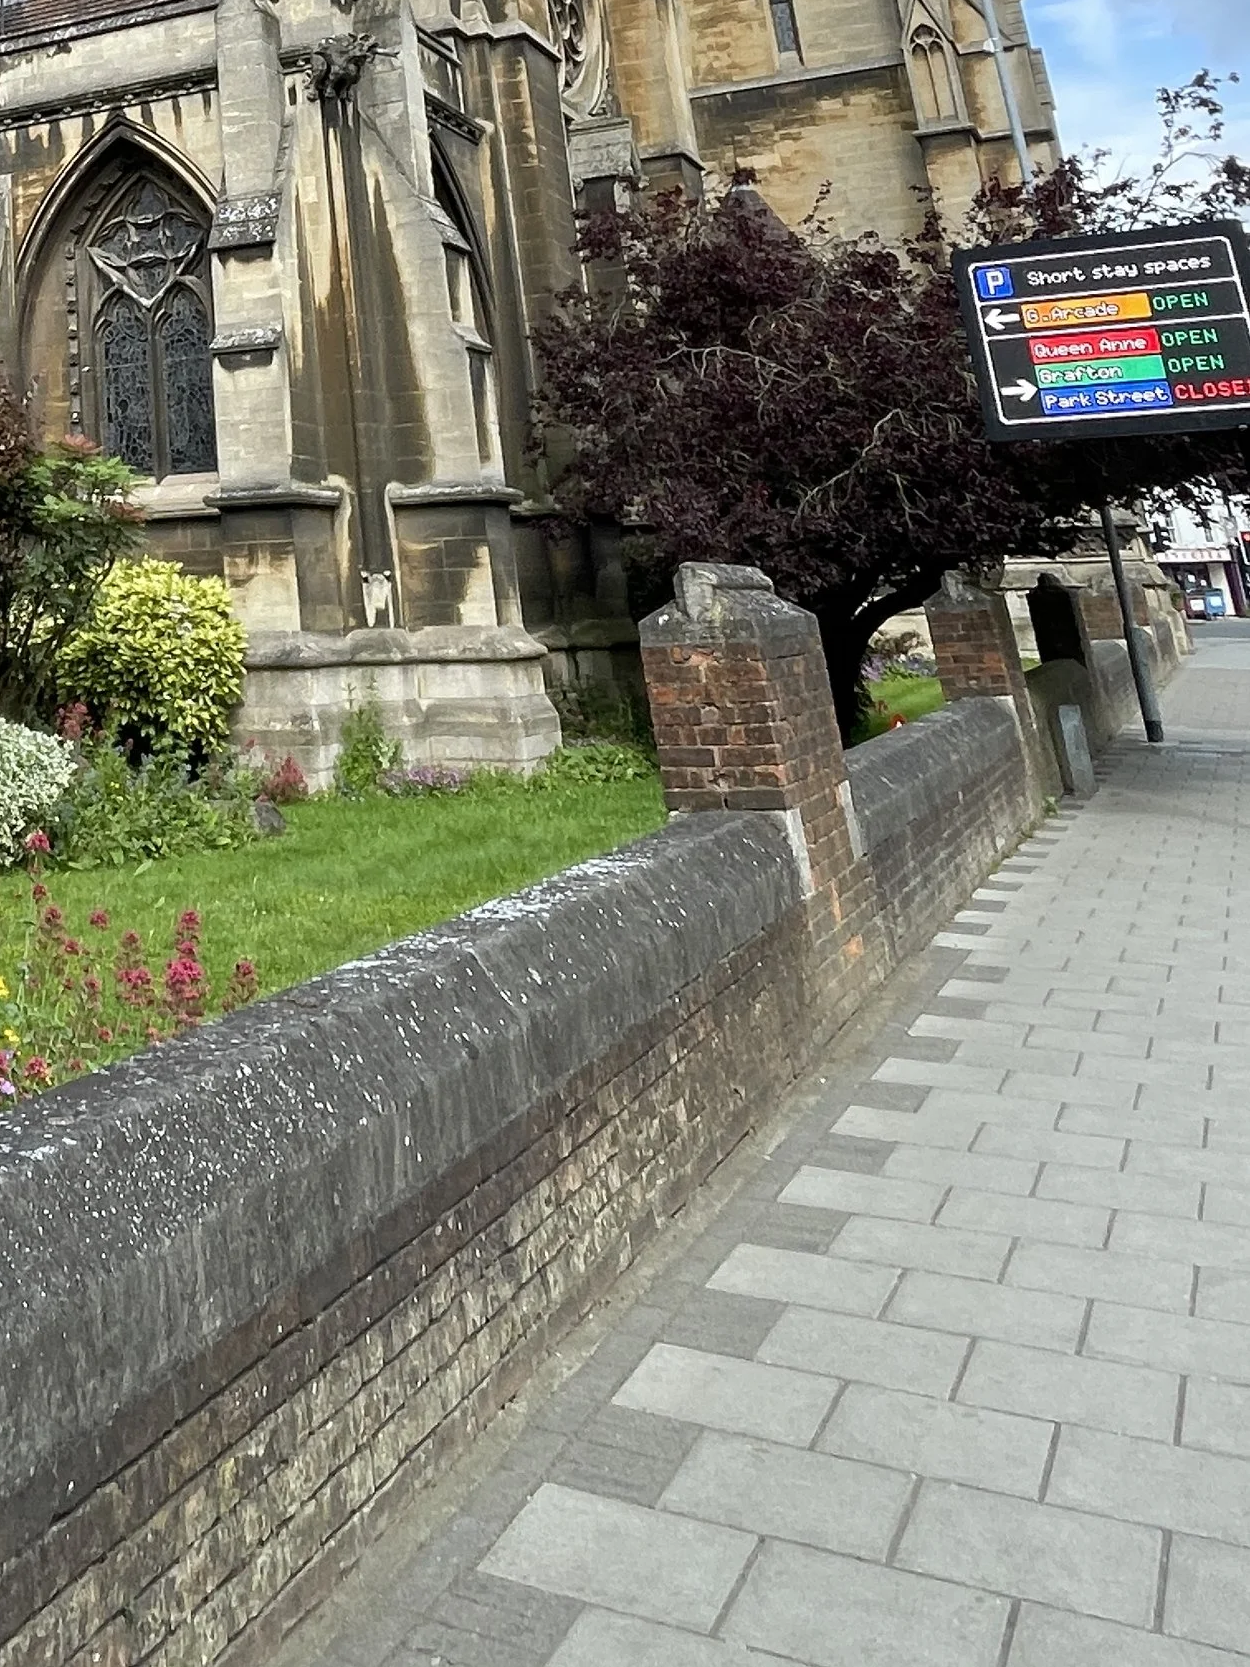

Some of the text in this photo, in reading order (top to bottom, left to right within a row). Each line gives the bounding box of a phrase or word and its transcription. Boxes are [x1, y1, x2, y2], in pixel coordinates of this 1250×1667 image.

[986, 255, 1212, 295] P Short stay spaces
[1152, 291, 1209, 311] OPEN
[1034, 327, 1218, 359] Queen Anne OPEN
[1038, 354, 1225, 383] Grafton OPEN
[1045, 378, 1250, 410] Park Street CLOSE
